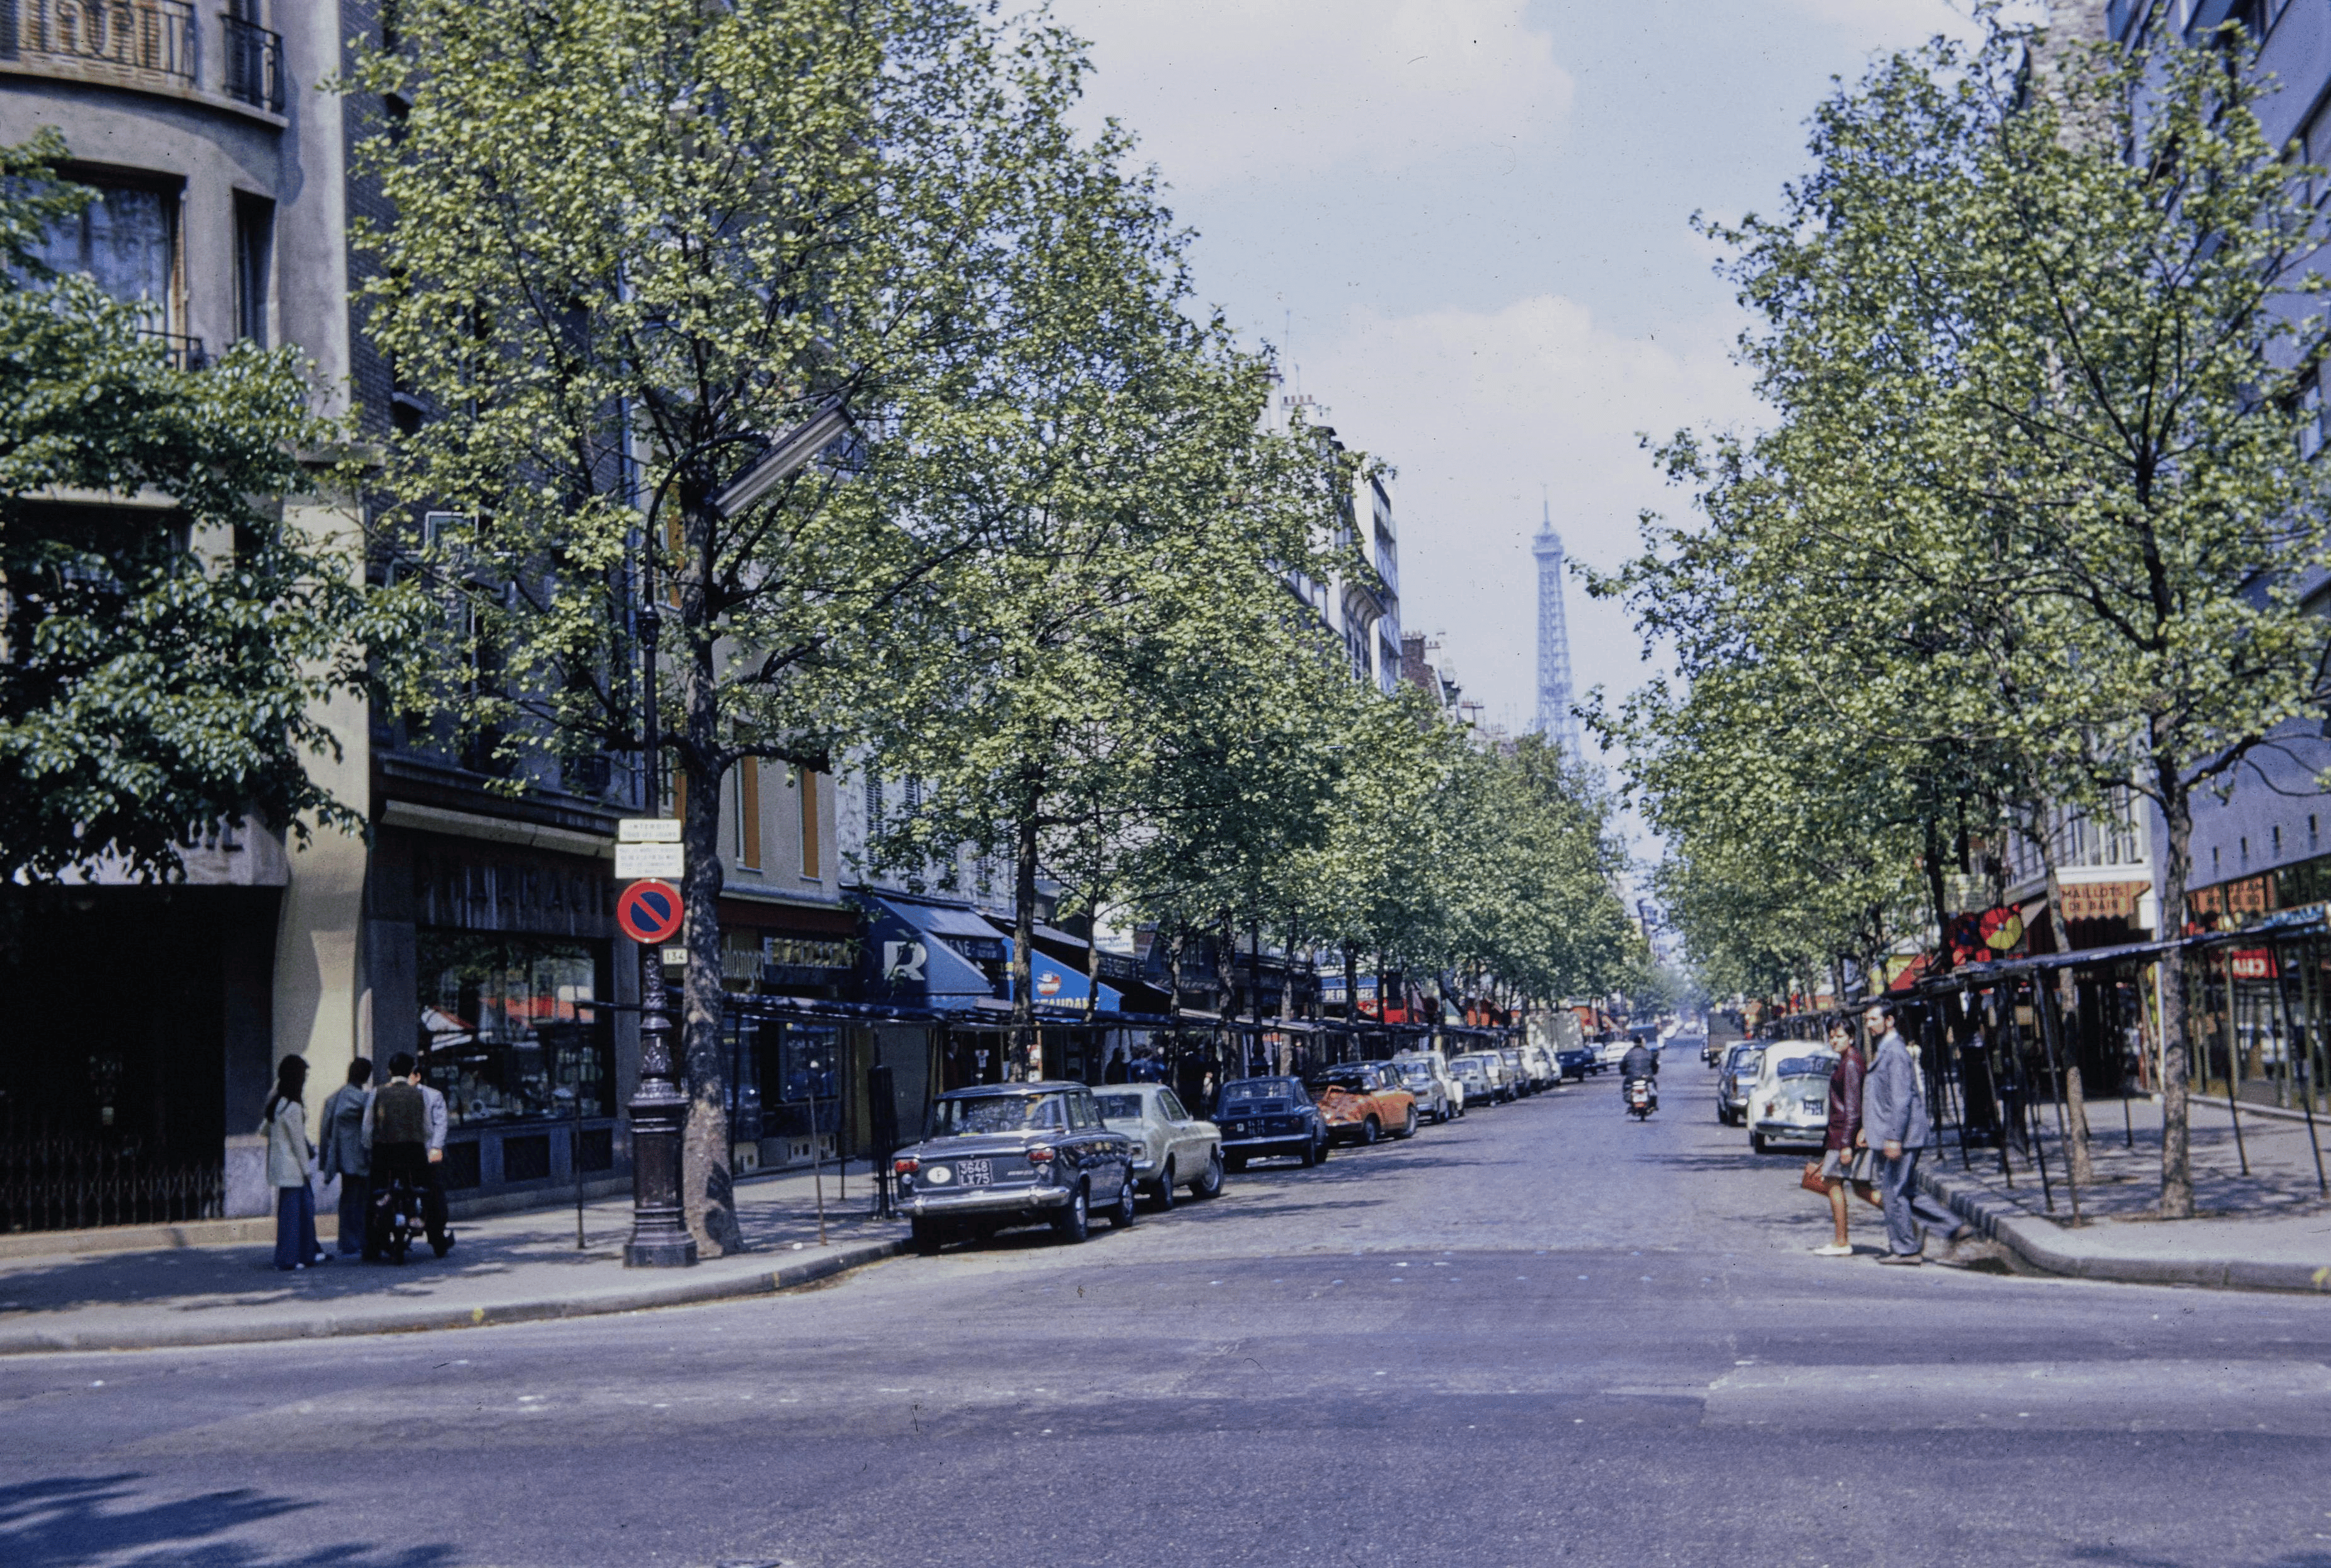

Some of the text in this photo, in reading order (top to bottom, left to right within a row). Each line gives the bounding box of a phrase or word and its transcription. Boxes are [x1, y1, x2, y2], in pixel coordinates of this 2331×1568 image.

[667, 951, 684, 961] 134
[959, 1161, 988, 1174] 3648
[960, 1172, 990, 1186] LX75
